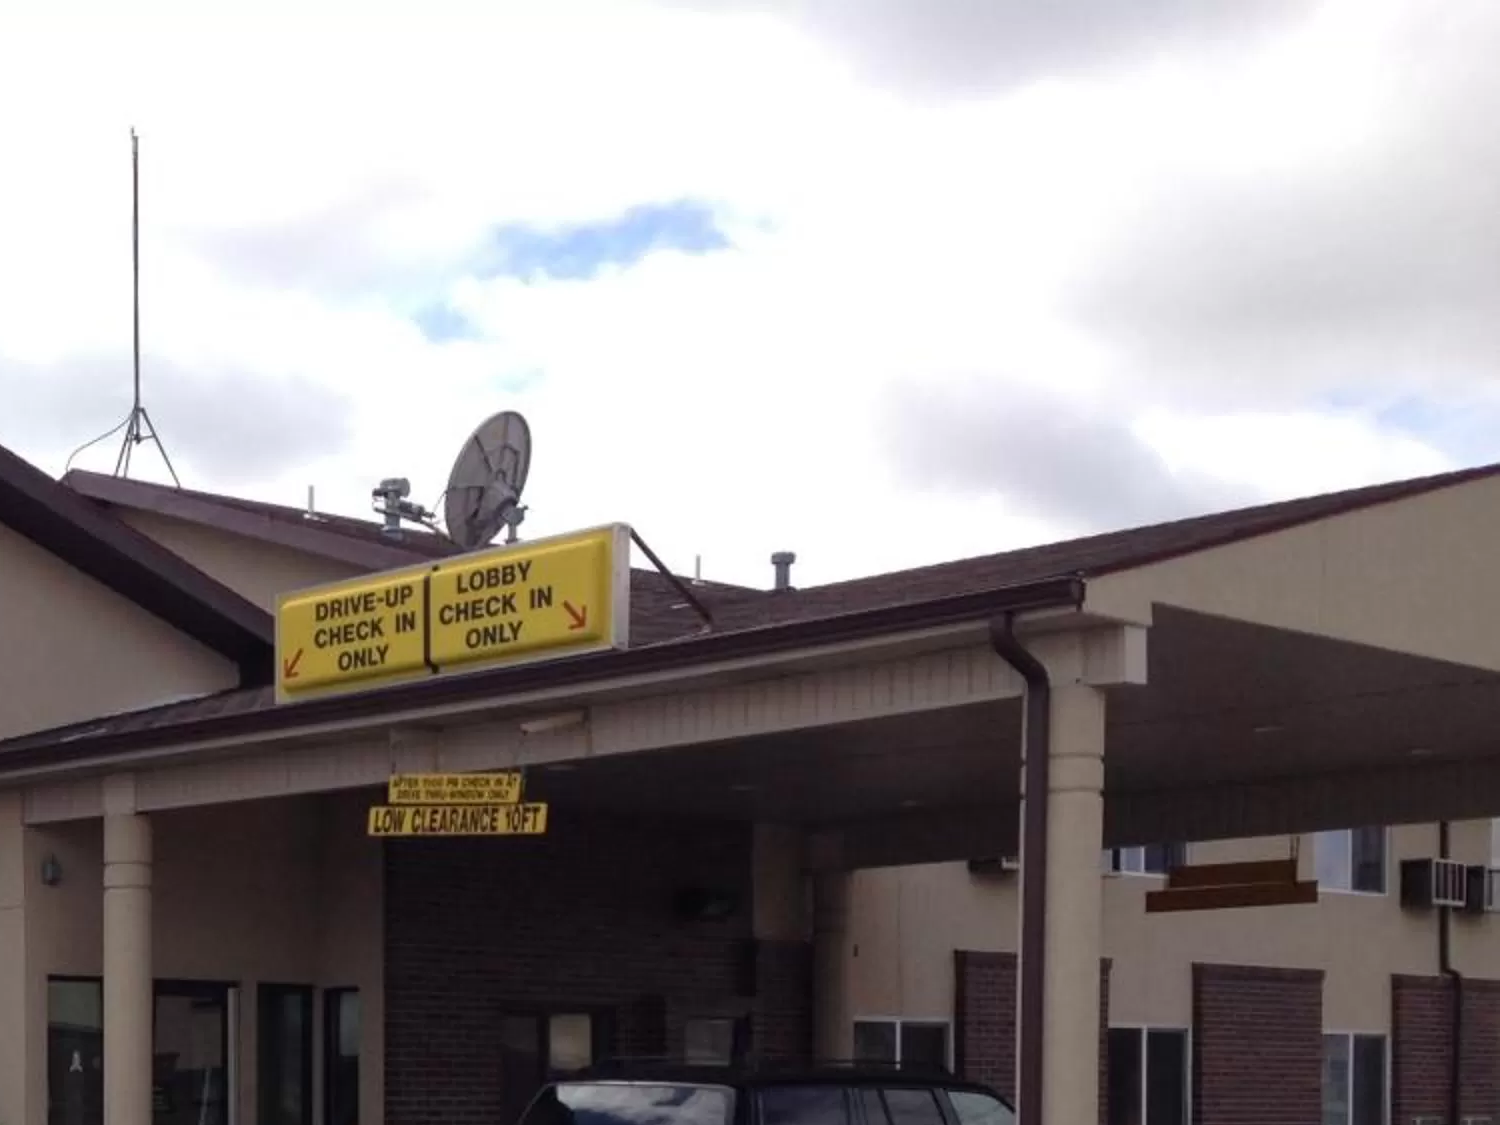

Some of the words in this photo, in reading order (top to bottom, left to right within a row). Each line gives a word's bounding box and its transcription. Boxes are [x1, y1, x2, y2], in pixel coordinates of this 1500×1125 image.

[456, 560, 532, 594] LOBBY
[315, 584, 413, 622] DRIVE-UP
[439, 592, 517, 626] CHECK
[529, 585, 553, 610] IN
[314, 618, 384, 649] CHECK
[395, 611, 416, 633] IN
[465, 620, 523, 649] ONLY
[338, 643, 390, 672] ONLY
[374, 808, 407, 833] LOW
[411, 806, 499, 833] CLEARANCE
[505, 805, 541, 832] 10FT
